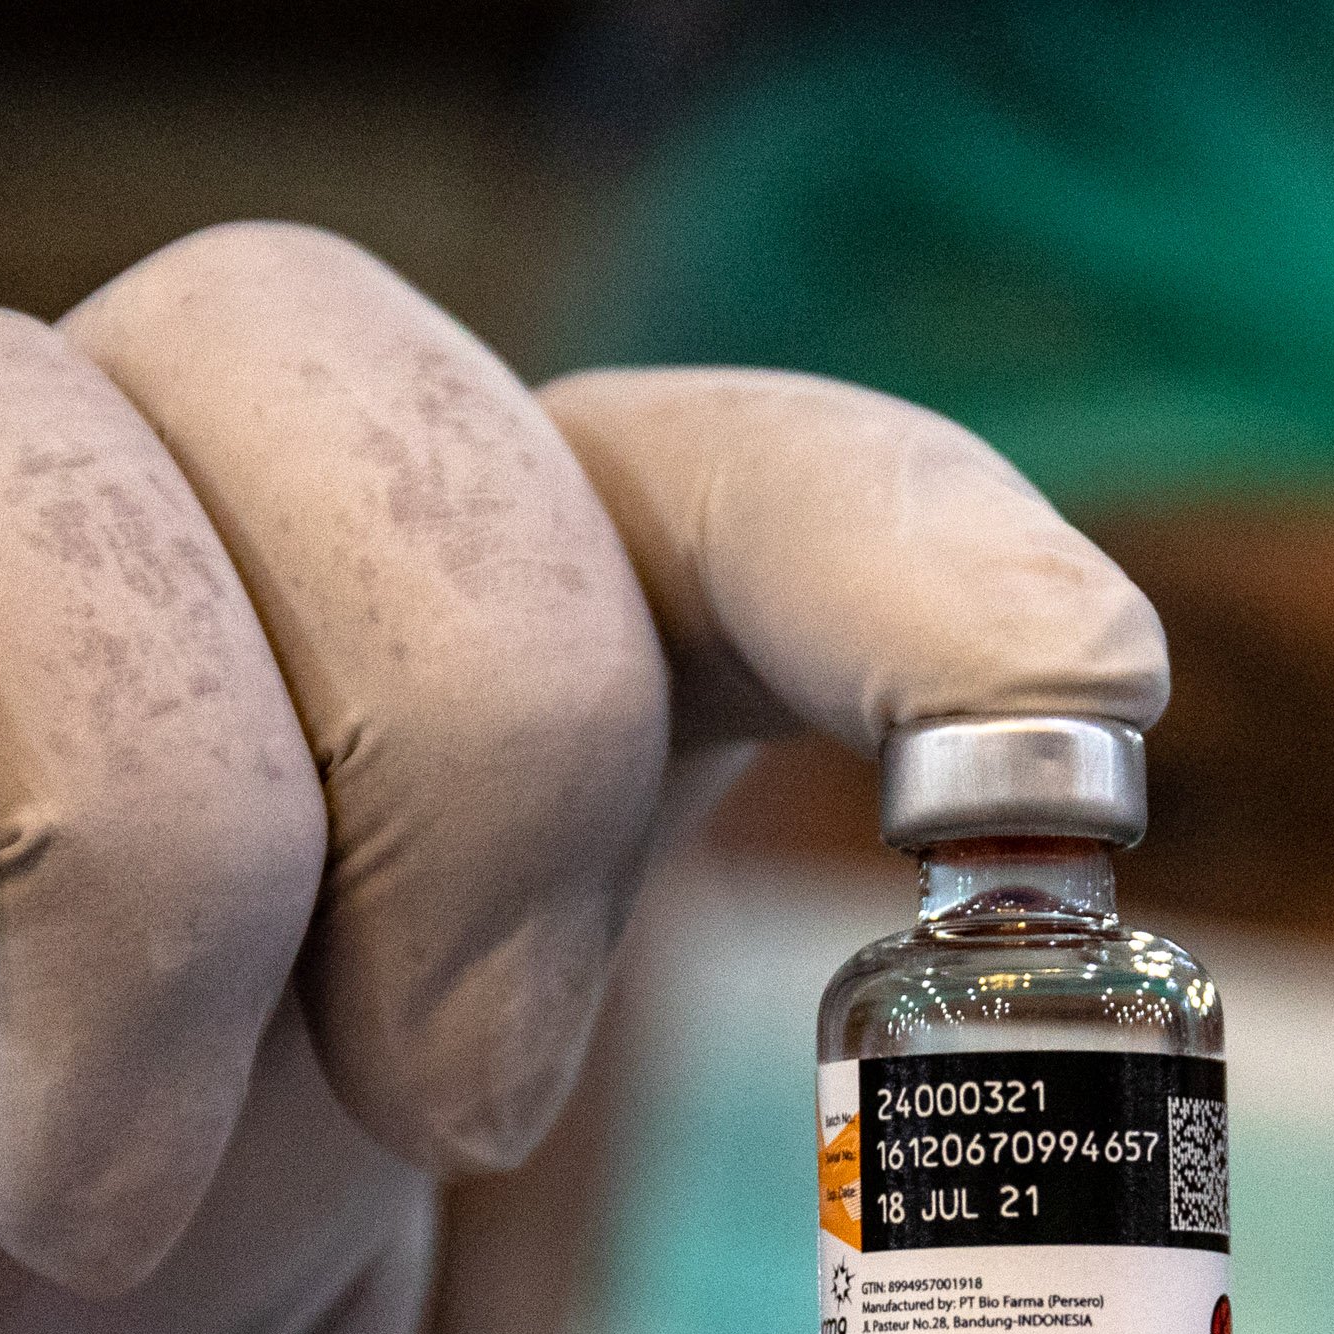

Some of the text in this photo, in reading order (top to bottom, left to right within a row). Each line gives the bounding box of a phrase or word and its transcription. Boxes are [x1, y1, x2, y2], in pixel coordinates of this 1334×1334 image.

[876, 1080, 1045, 1120] 24000321
[876, 1130, 1160, 1171] 16120670994657
[877, 1184, 1039, 1225] 18 JUL 21
[861, 1276, 983, 1295] GTIN: 8994957001918
[861, 1294, 1104, 1314] Manufactured by: PT Bio Farma (Persero)
[872, 1319, 910, 1332] Pasteur
[912, 1316, 950, 1330] No.28,
[953, 1314, 1093, 1330] Bandung-INDONESIA
